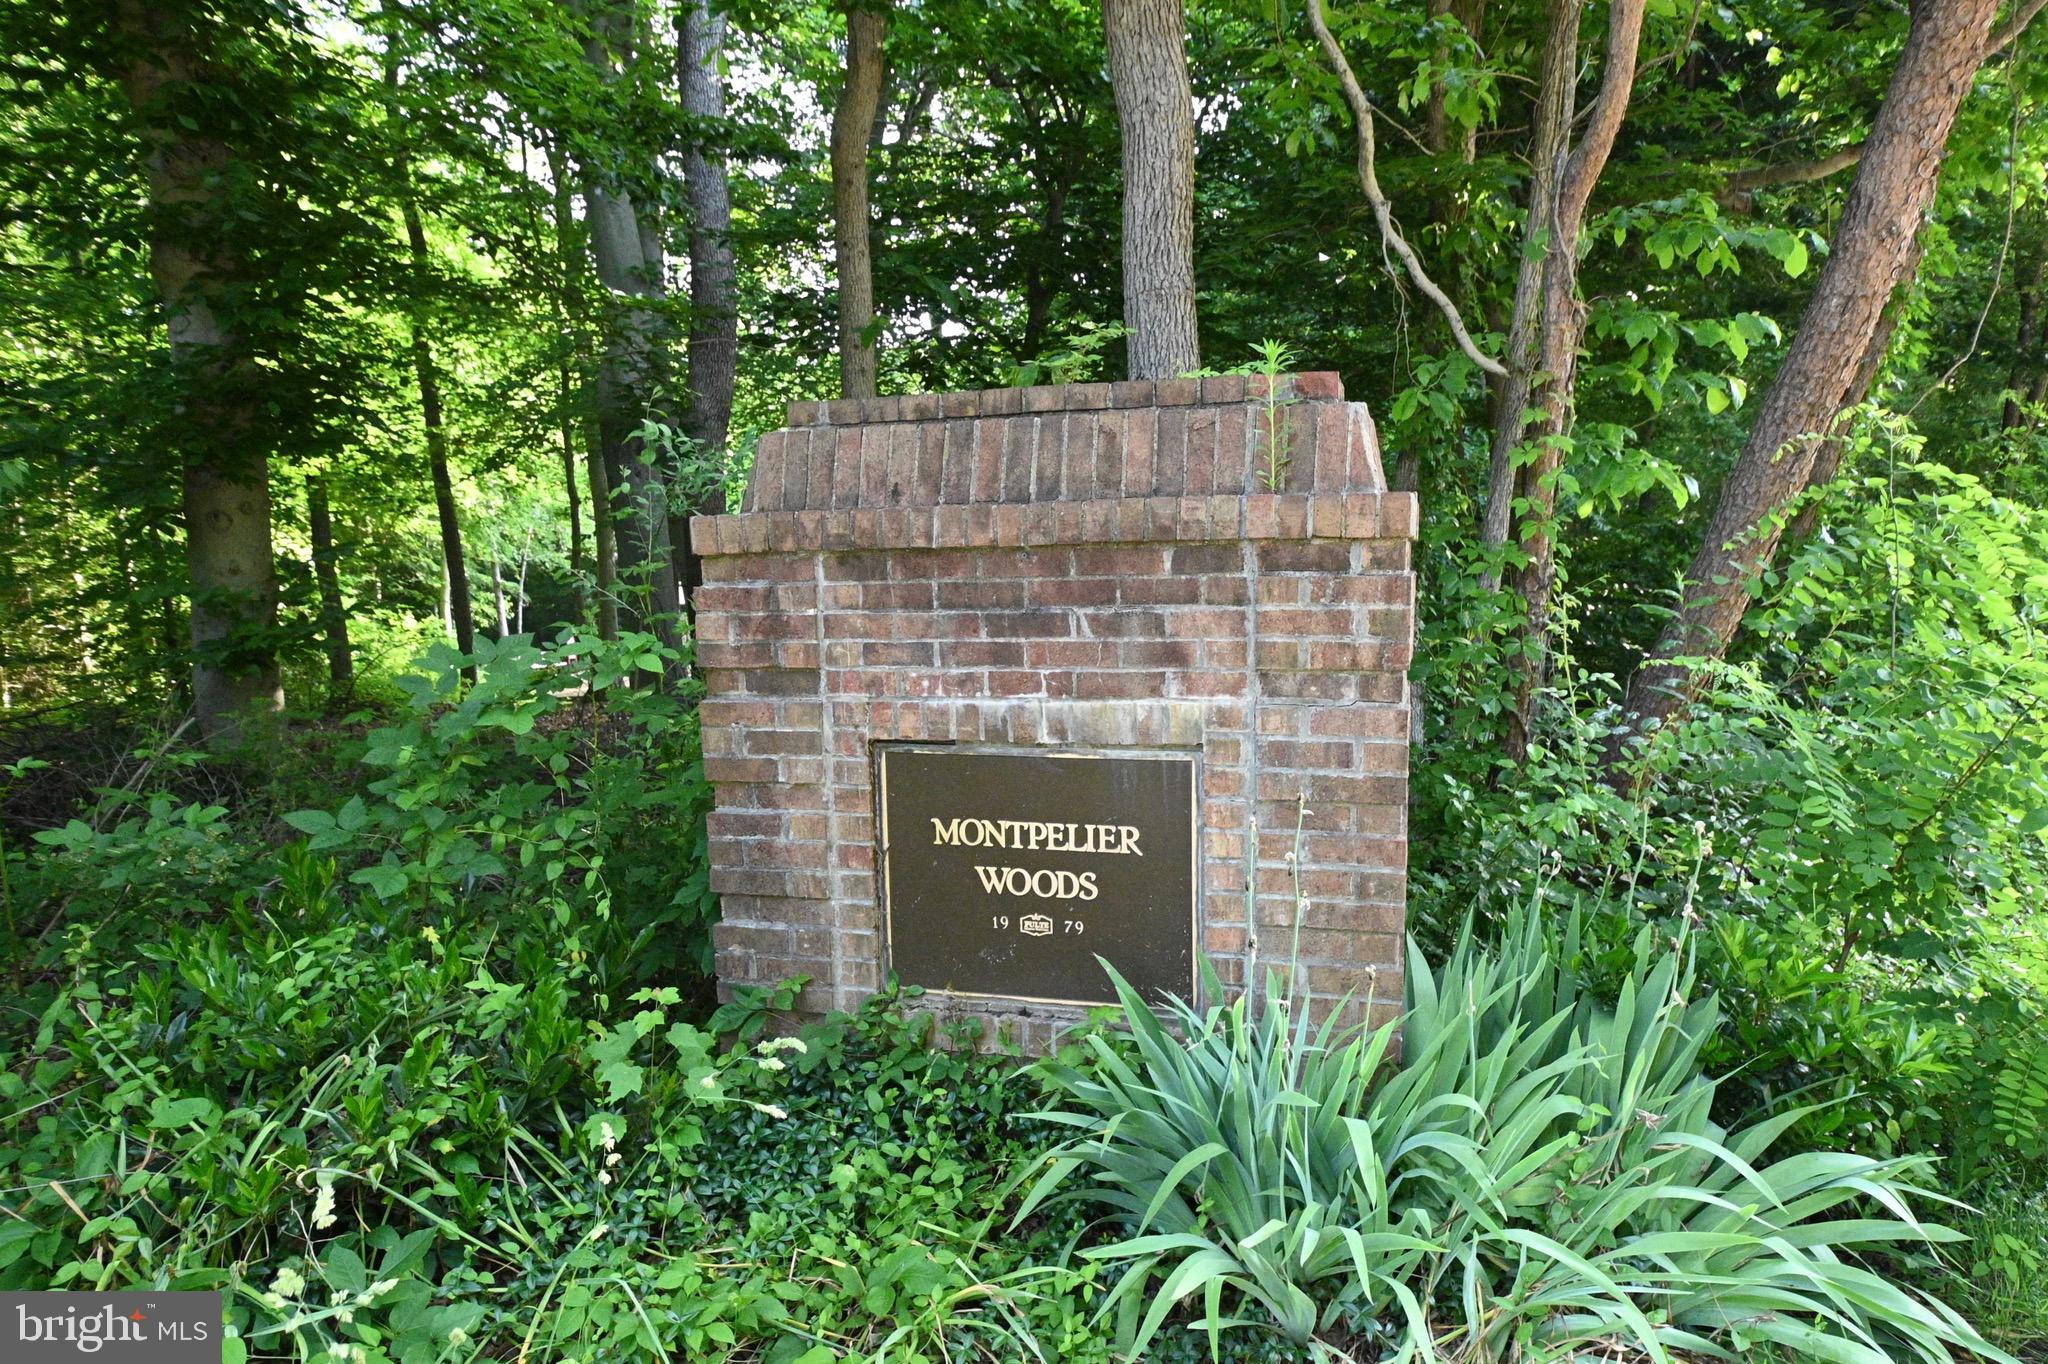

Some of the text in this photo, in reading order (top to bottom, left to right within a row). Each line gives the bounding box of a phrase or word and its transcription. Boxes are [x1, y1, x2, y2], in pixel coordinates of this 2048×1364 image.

[930, 817, 1143, 856] MONTPELIER
[974, 865, 1099, 901] WOODS
[992, 915, 1084, 935] 19 79
